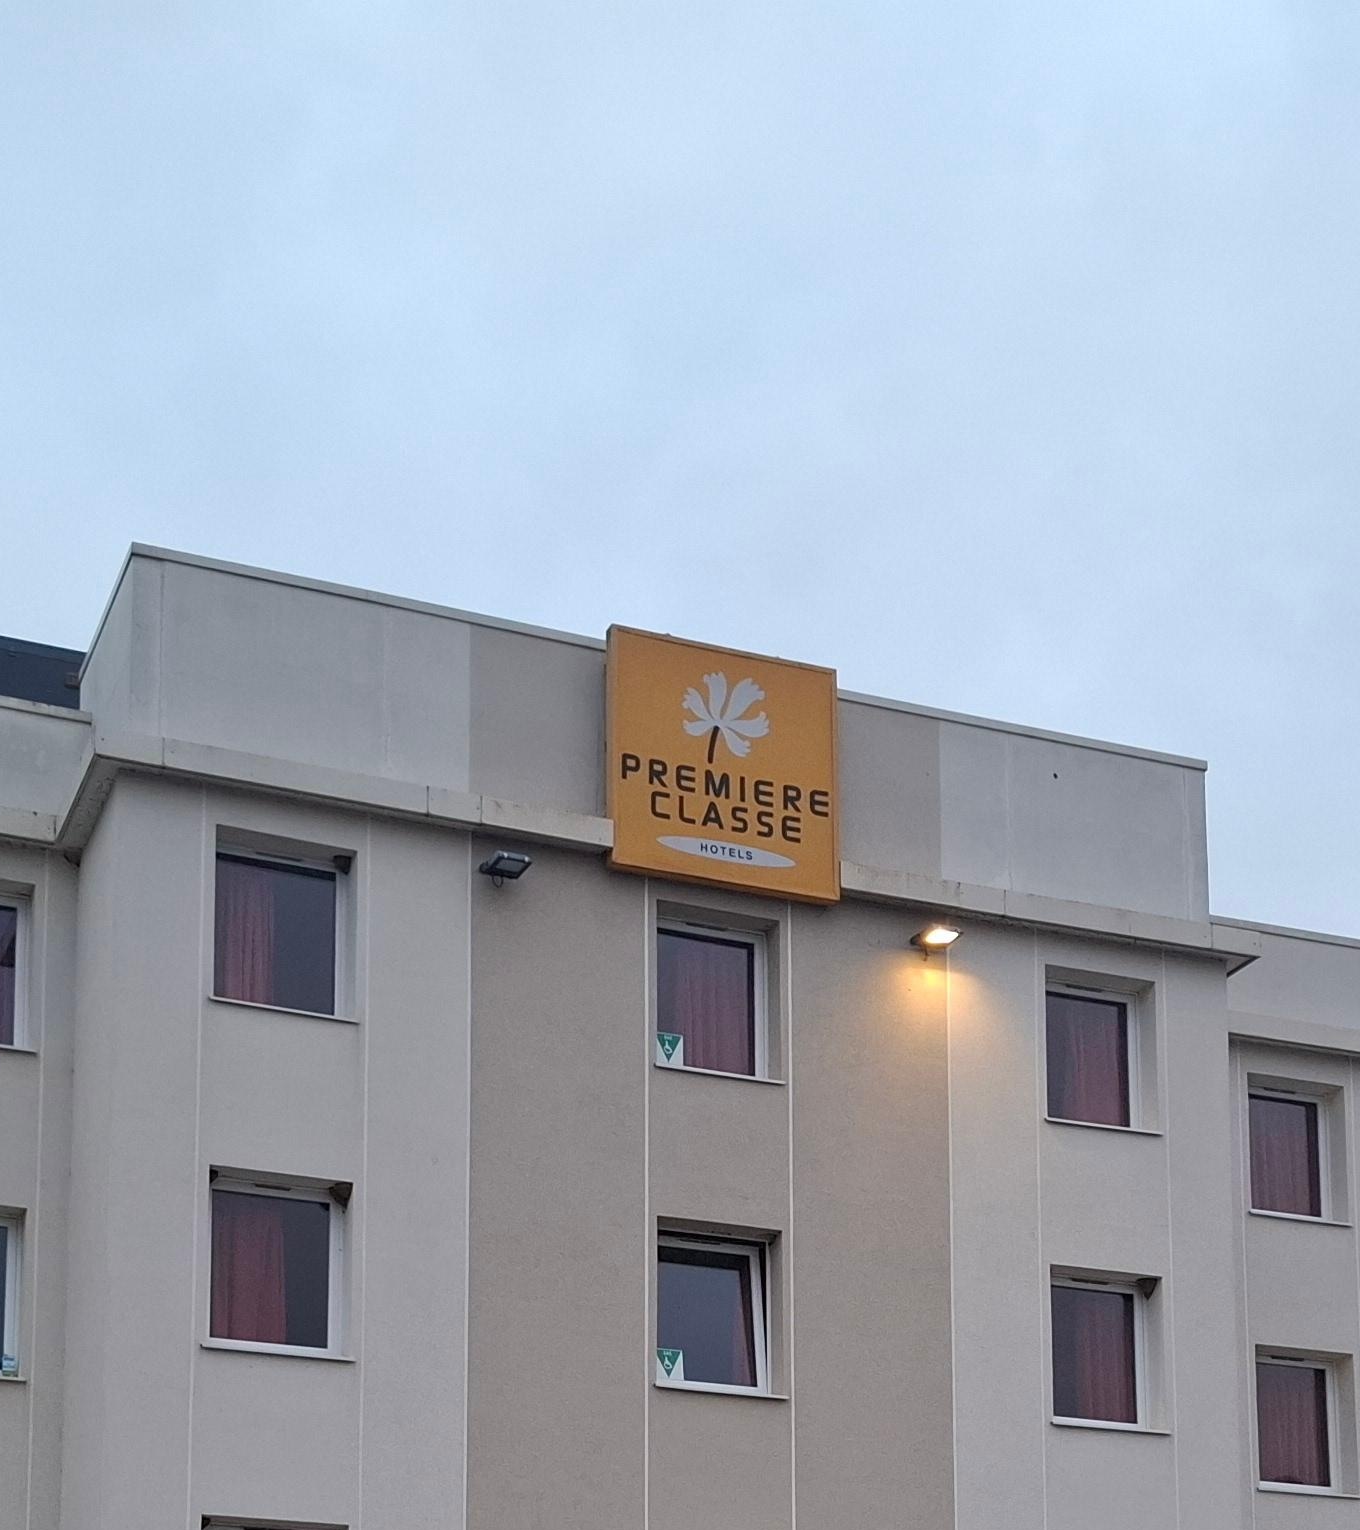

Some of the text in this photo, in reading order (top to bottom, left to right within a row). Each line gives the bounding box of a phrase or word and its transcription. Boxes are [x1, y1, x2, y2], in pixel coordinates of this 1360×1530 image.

[621, 753, 830, 818] PREMIERE
[650, 791, 802, 843] CLASSE
[700, 842, 753, 861] HOTELS
